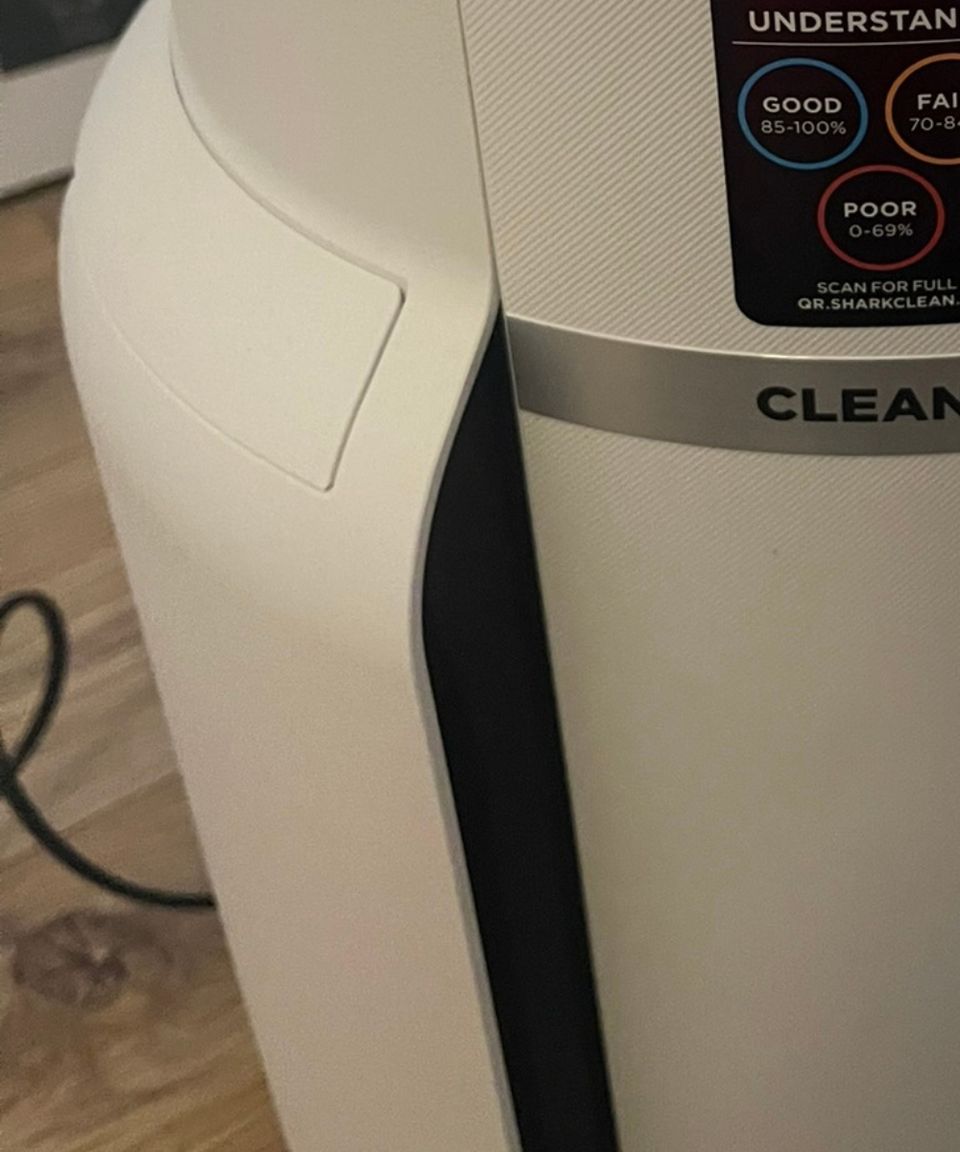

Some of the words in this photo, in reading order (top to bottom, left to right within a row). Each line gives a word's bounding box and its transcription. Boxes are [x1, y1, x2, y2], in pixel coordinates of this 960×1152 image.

[763, 96, 842, 114] GOOD
[760, 120, 847, 135] 85-100%
[843, 201, 917, 218] POOR
[849, 223, 914, 238] 0-69%
[817, 281, 866, 294] SCAN
[872, 280, 909, 293] FOR
[913, 278, 957, 292] FULL
